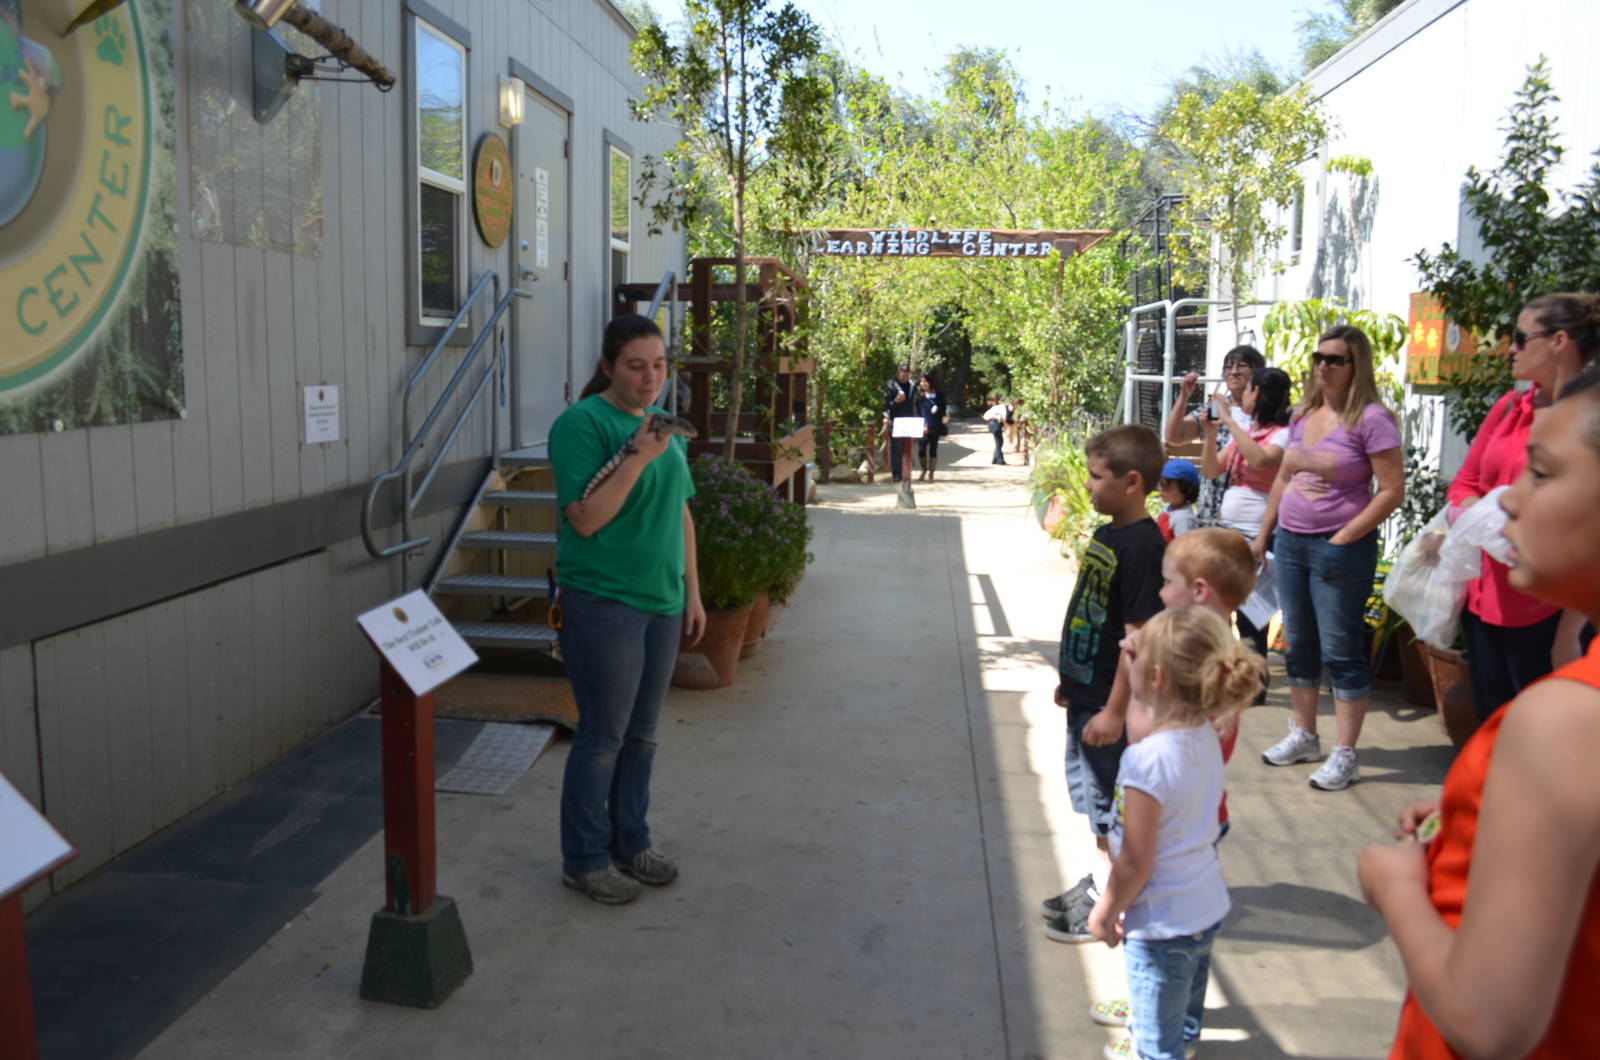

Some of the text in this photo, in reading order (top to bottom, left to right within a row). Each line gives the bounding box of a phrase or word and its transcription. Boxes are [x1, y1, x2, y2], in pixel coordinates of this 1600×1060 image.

[16, 103, 132, 336] CENTER
[868, 231, 992, 244] WILDLIFE
[812, 240, 1052, 256] LEARNING CENTER
